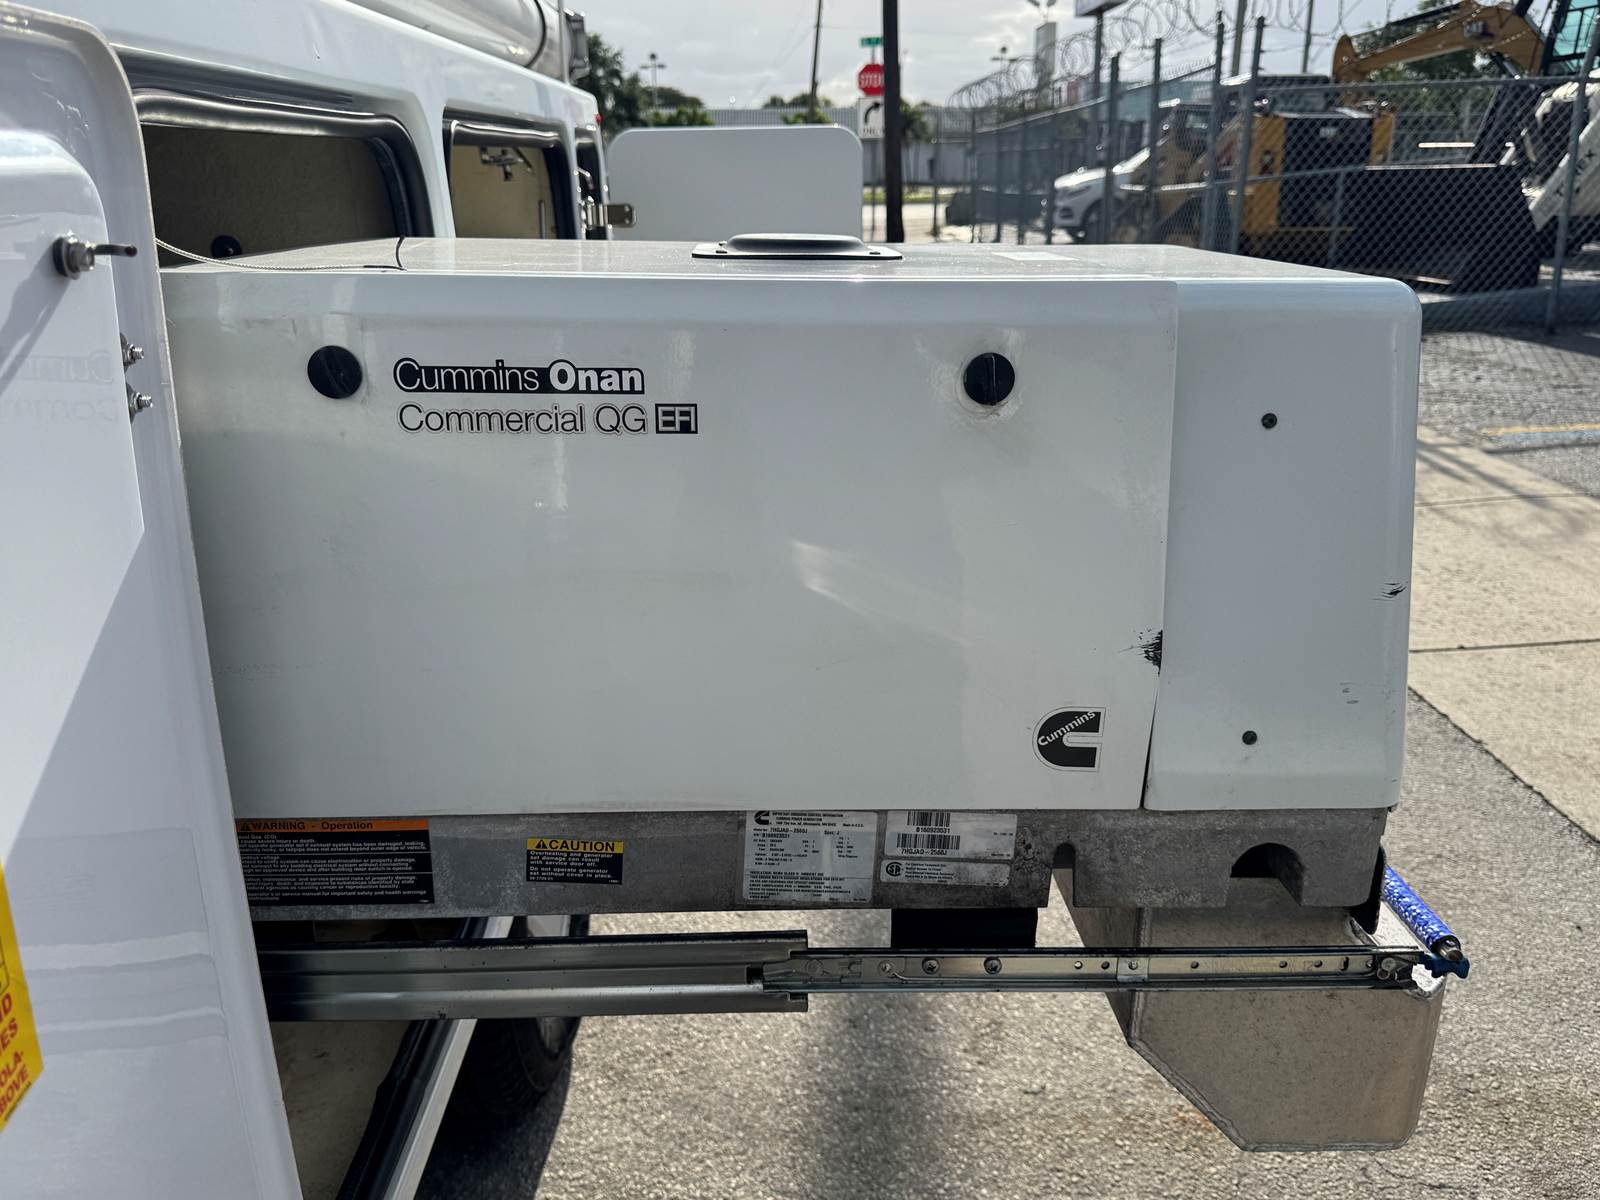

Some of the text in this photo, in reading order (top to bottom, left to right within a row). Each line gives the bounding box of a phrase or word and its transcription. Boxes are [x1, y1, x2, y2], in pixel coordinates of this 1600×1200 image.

[396, 358, 643, 391] Cummins Onan
[399, 403, 697, 433] Commercial QG EFI
[1037, 710, 1096, 746] Cummins
[252, 821, 305, 830] WARNING
[321, 820, 373, 831] Operation
[549, 840, 614, 852] CAUTION
